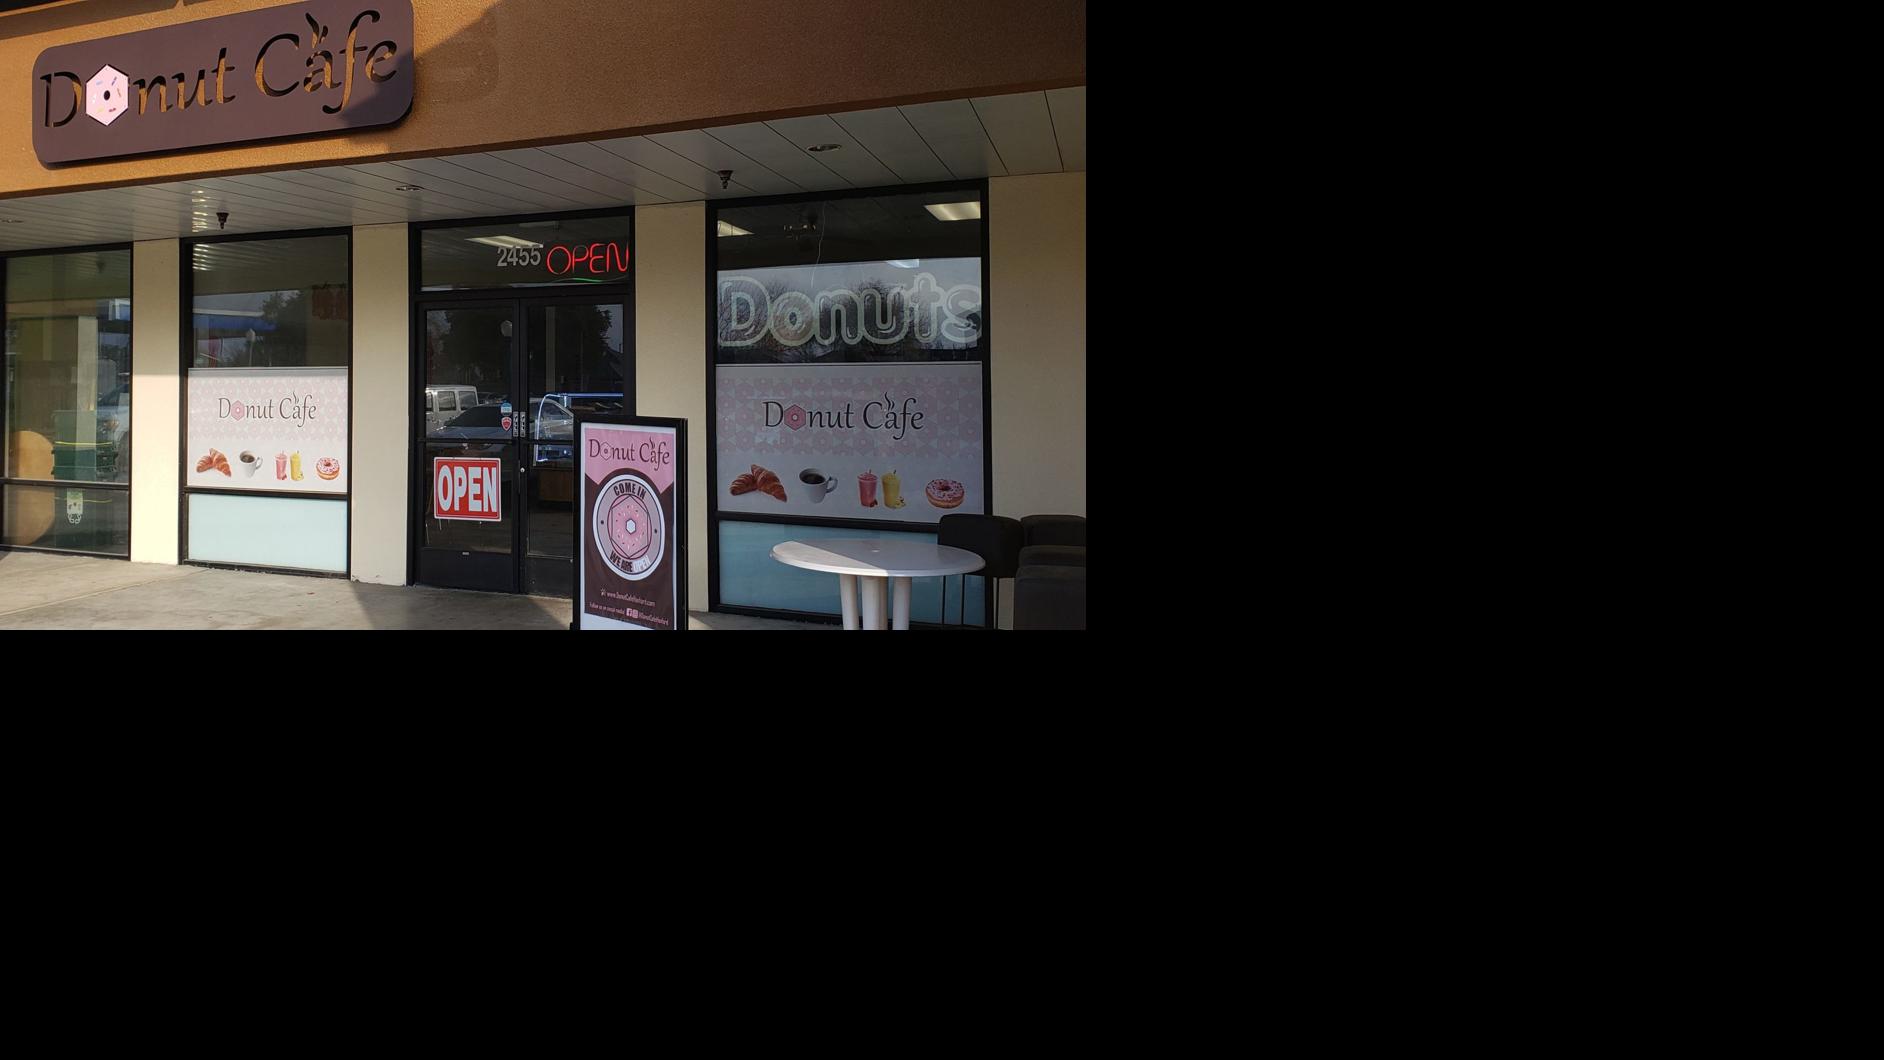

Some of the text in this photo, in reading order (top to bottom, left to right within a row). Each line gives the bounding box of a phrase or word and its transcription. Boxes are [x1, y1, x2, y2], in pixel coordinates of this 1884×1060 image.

[40, 47, 236, 128] Donut
[496, 245, 541, 267] 2455
[546, 242, 629, 275] OPEN
[718, 271, 982, 348] Donuts
[218, 396, 274, 421] Donut
[763, 399, 854, 431] Donut
[588, 438, 636, 461] Donut
[437, 464, 498, 513] OPEN
[613, 482, 647, 500] COME IN
[609, 550, 651, 573] WE ARE OPEN
